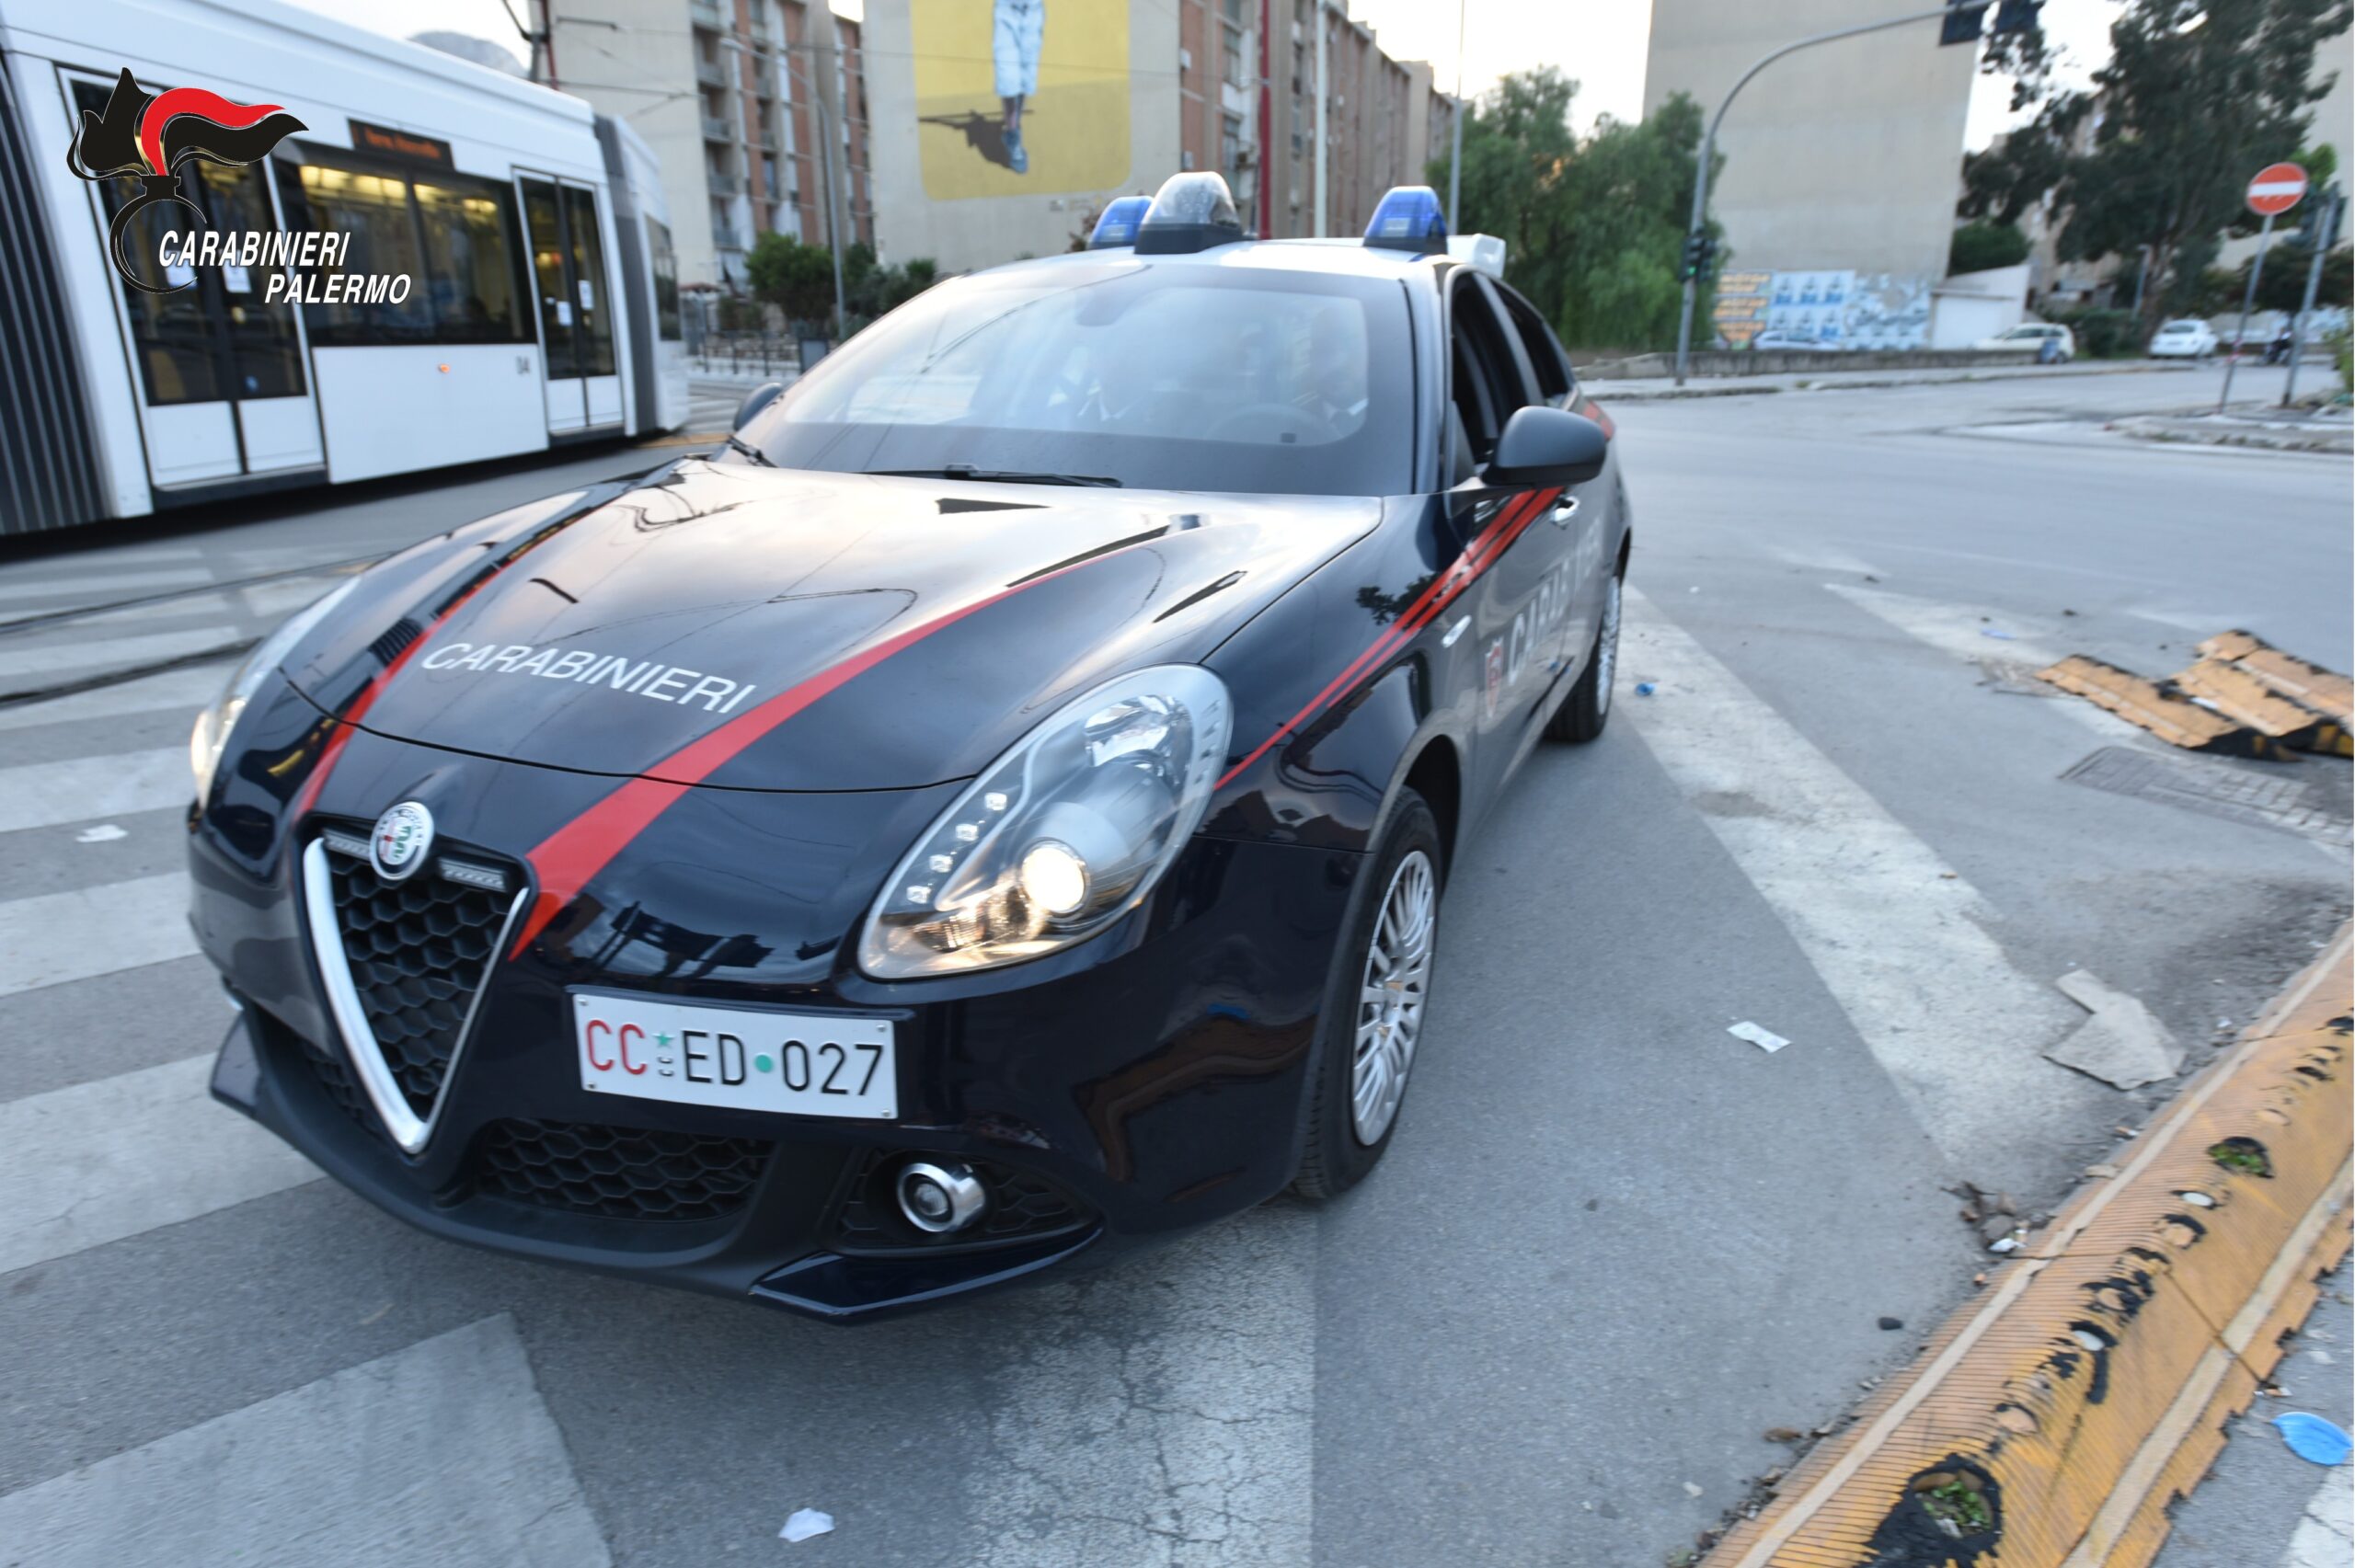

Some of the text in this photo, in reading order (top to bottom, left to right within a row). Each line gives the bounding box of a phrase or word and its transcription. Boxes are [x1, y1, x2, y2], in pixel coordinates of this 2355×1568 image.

[420, 642, 757, 714] CARABINIERI
[586, 1019, 648, 1075] CC
[682, 1029, 748, 1086] ED
[781, 1039, 884, 1096] 027
